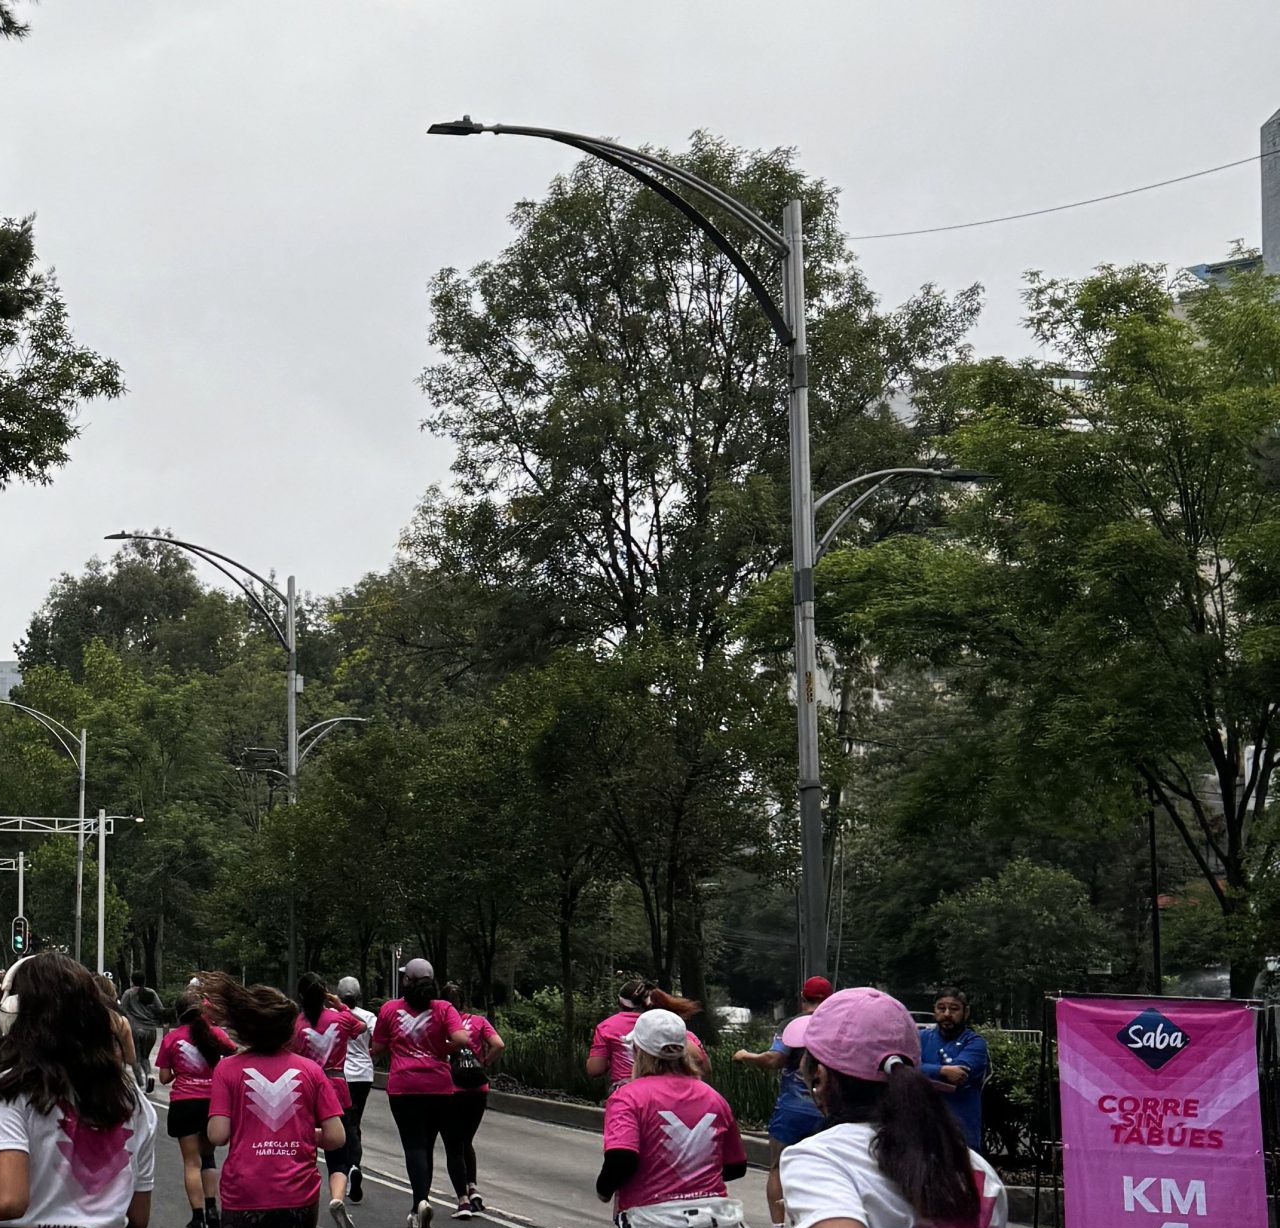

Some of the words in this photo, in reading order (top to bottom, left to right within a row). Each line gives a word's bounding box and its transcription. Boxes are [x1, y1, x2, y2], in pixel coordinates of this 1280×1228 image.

[1127, 1023, 1185, 1049] Saba
[1098, 1094, 1200, 1118] CORRE
[1120, 1112, 1164, 1129] SIN
[1110, 1122, 1224, 1149] TABÚES
[1123, 1175, 1207, 1216] KM
